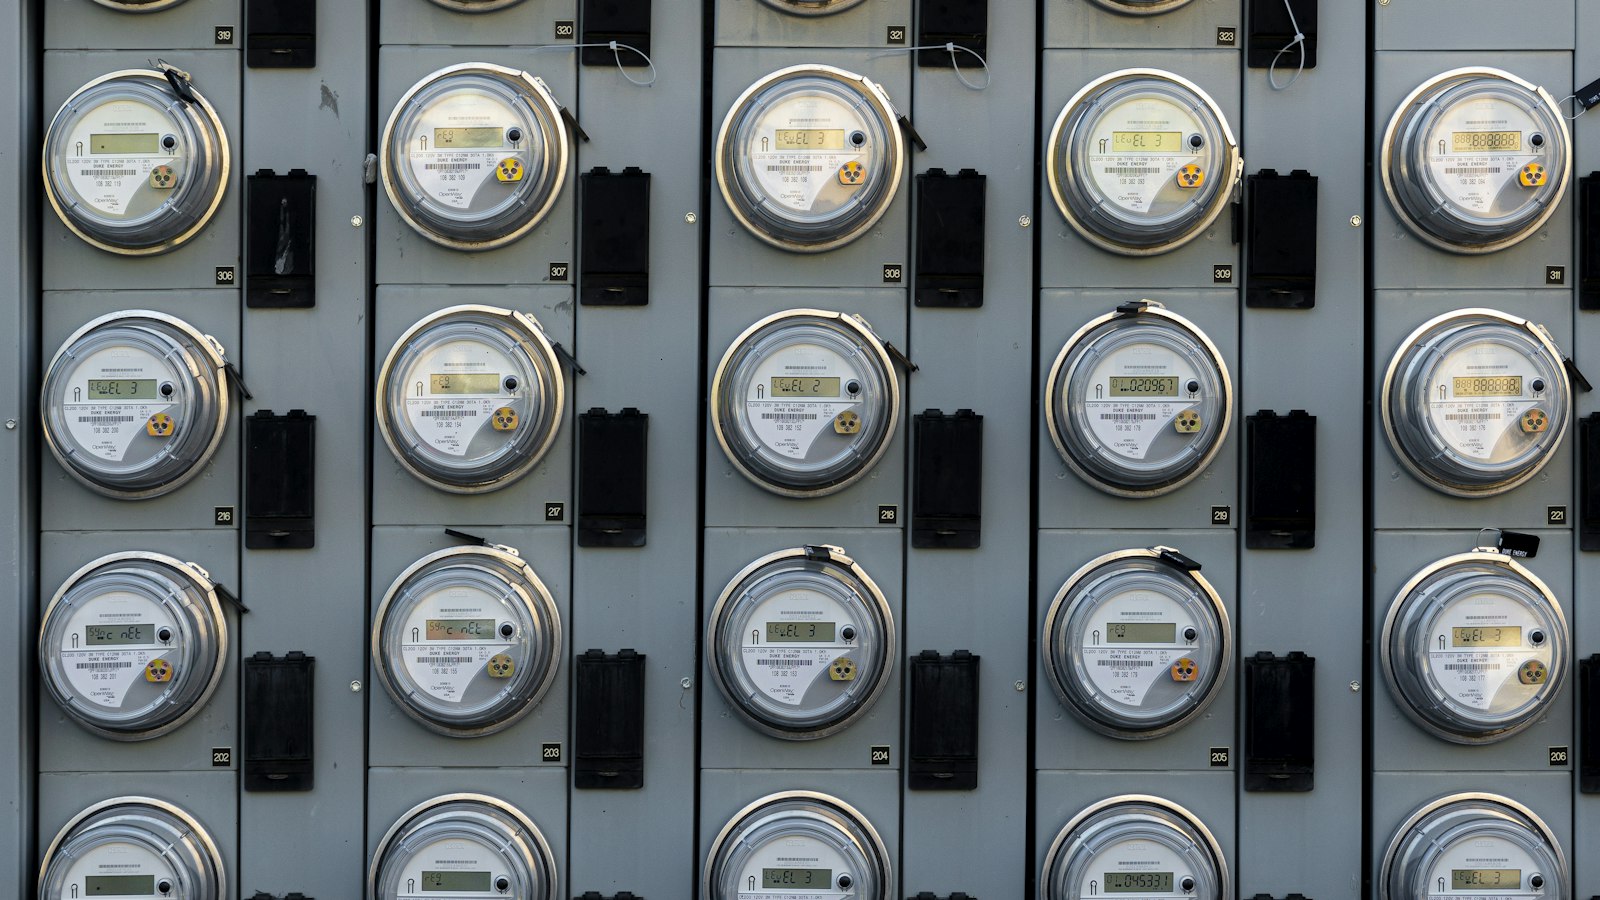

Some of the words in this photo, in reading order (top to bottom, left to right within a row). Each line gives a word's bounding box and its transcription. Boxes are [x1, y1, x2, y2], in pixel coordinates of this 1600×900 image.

[557, 26, 572, 34] 320
[218, 31, 231, 40] 319
[890, 31, 902, 39] 321
[1219, 32, 1233, 41] 323
[818, 132, 824, 144] 3
[1156, 134, 1162, 146] 3
[218, 272, 233, 280] 306
[551, 267, 566, 276] 307
[885, 269, 900, 278] 308
[1215, 270, 1230, 278] 309
[1550, 271, 1560, 279] 311
[131, 382, 137, 394] 3
[813, 380, 820, 392] 2
[1129, 379, 1173, 392] 020967
[548, 507, 560, 516] 217
[881, 510, 894, 519] 218
[1214, 511, 1227, 520] 219
[1551, 511, 1563, 520] 221
[218, 512, 230, 521] 216
[809, 625, 816, 637] 3
[1495, 629, 1501, 641] 3
[214, 753, 229, 761] 202
[544, 748, 559, 757] 203
[873, 751, 888, 760] 204
[1212, 753, 1227, 761] 205
[1551, 752, 1566, 761] 206
[805, 871, 812, 883] 3
[1125, 875, 1167, 887] 045331
[1495, 872, 1500, 884] 3
